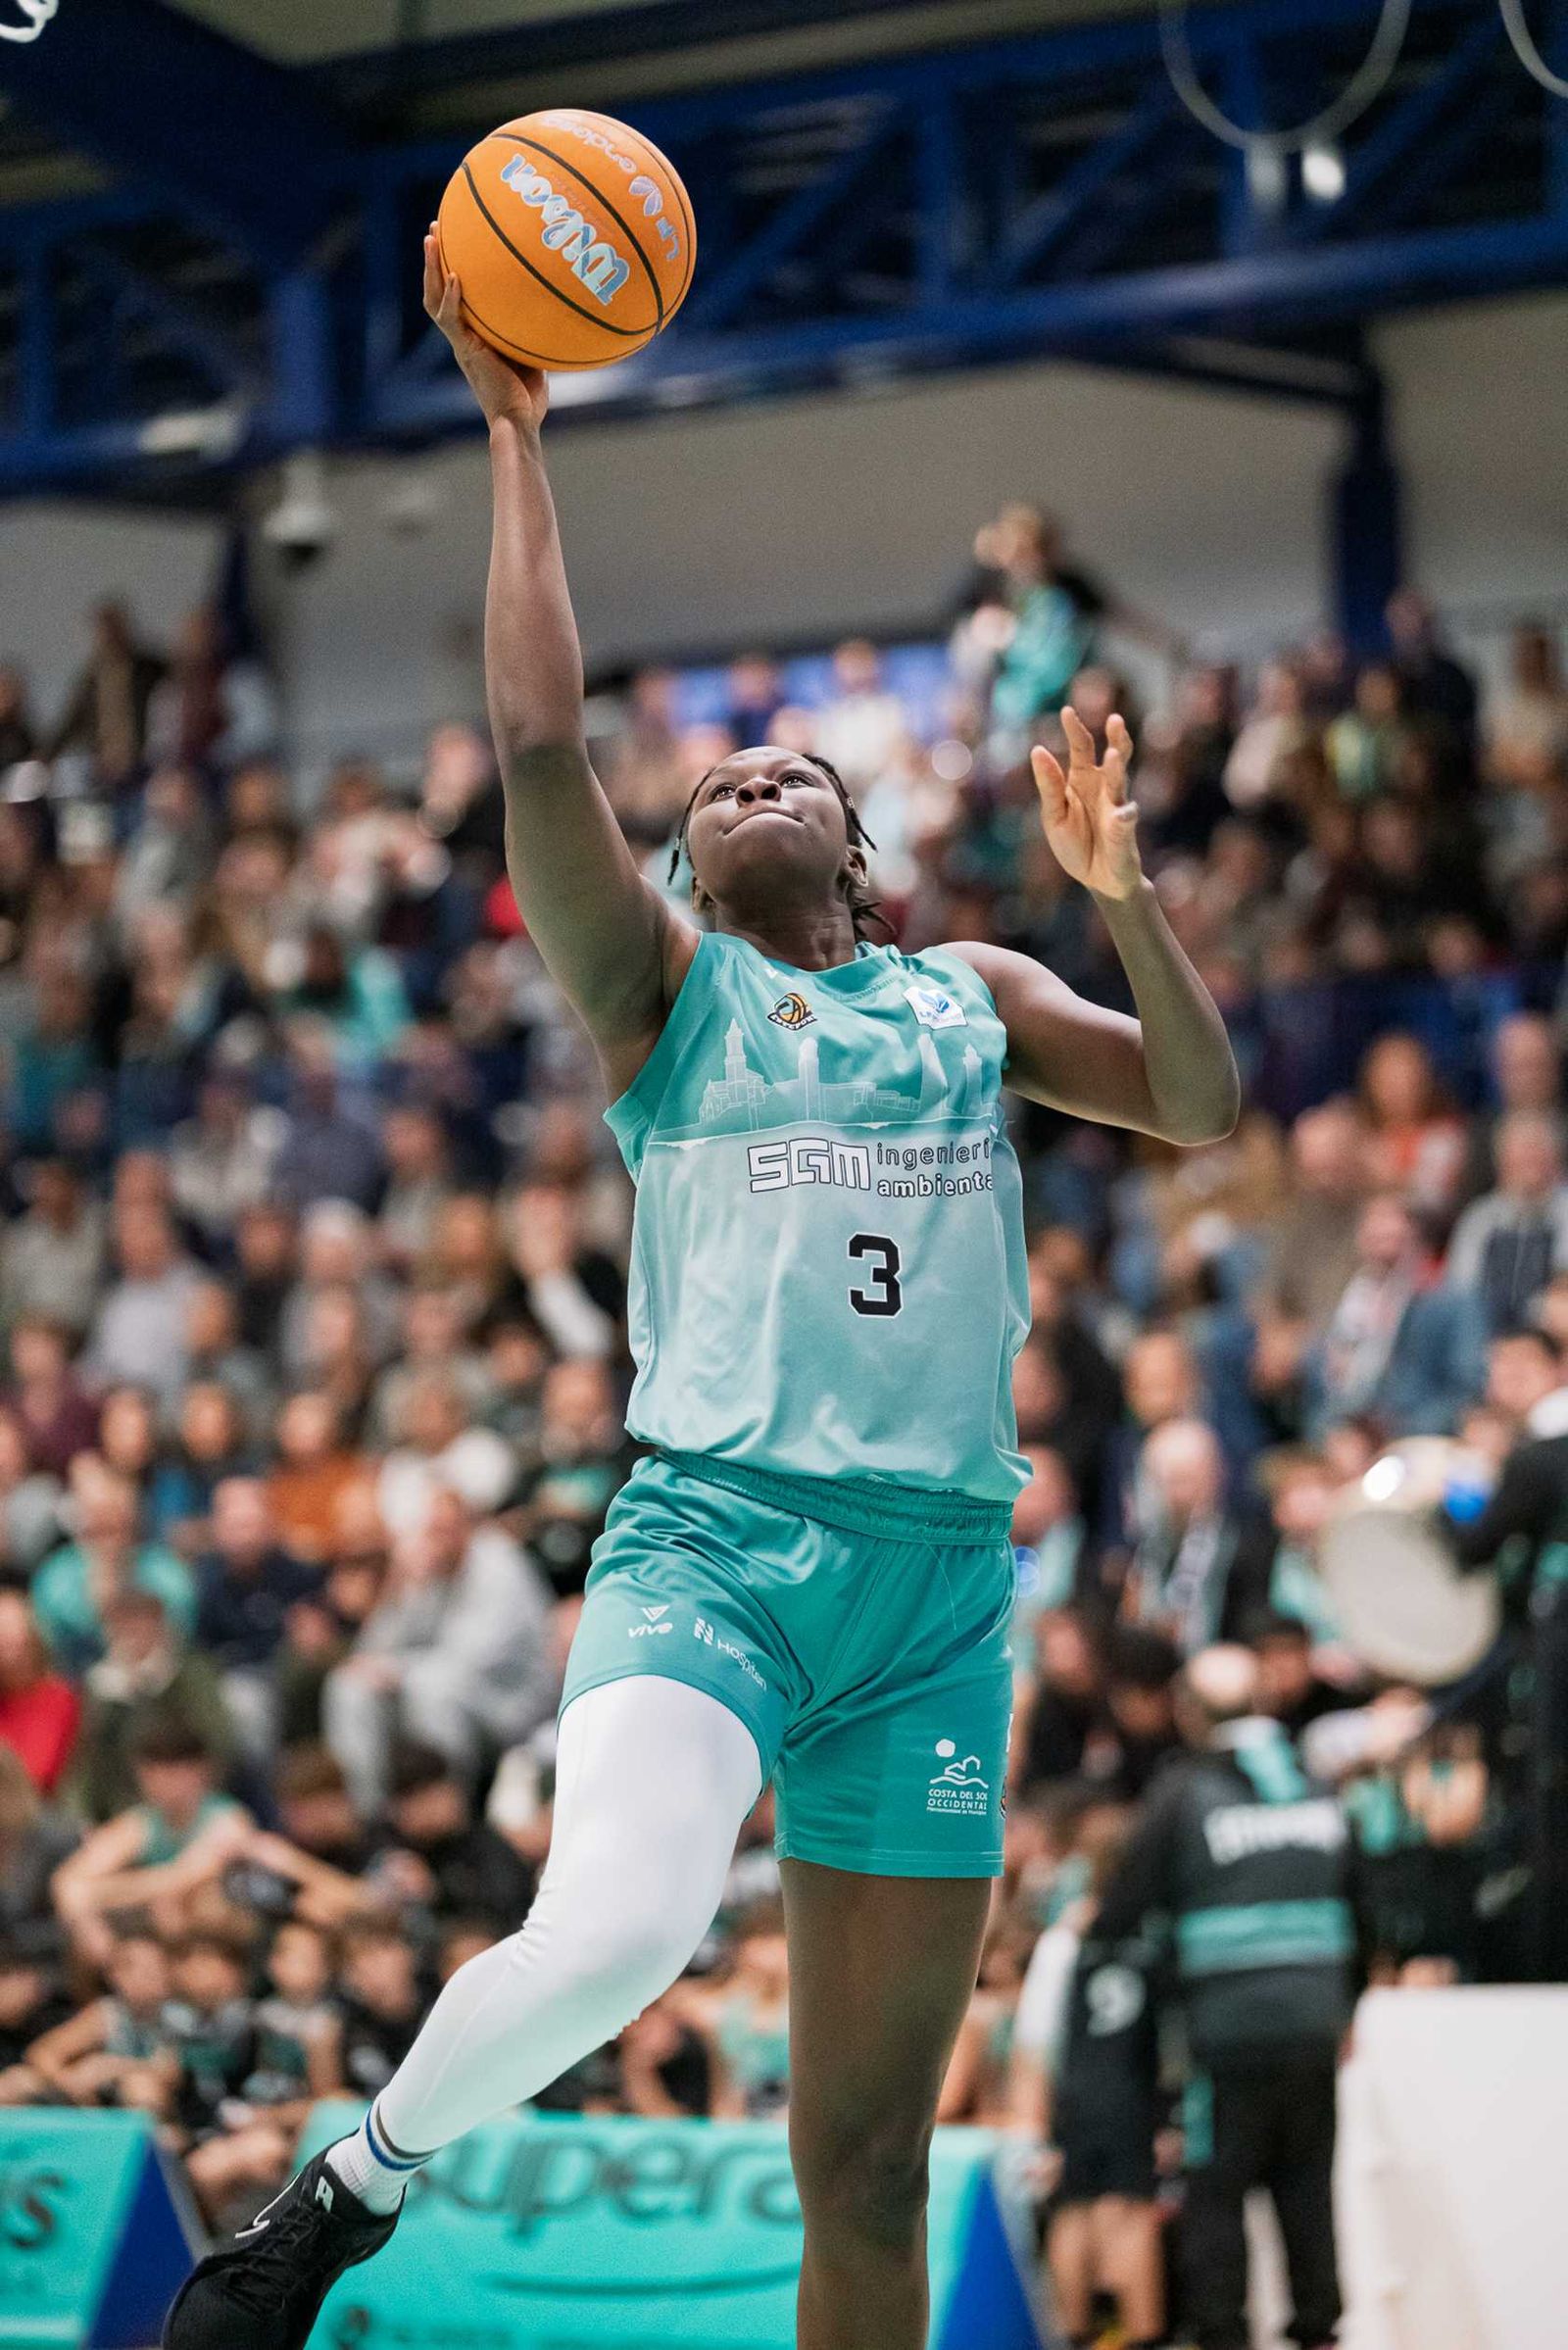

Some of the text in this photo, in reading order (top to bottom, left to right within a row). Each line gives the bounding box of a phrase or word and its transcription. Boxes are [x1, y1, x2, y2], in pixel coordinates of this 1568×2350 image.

[500, 153, 630, 306] Wilson
[747, 1137, 871, 1194] SGM
[848, 1233, 904, 1318] 3
[927, 1798, 987, 1810] OCCIDENTAL
[928, 1788, 988, 1801] COSTA DEL SOL
